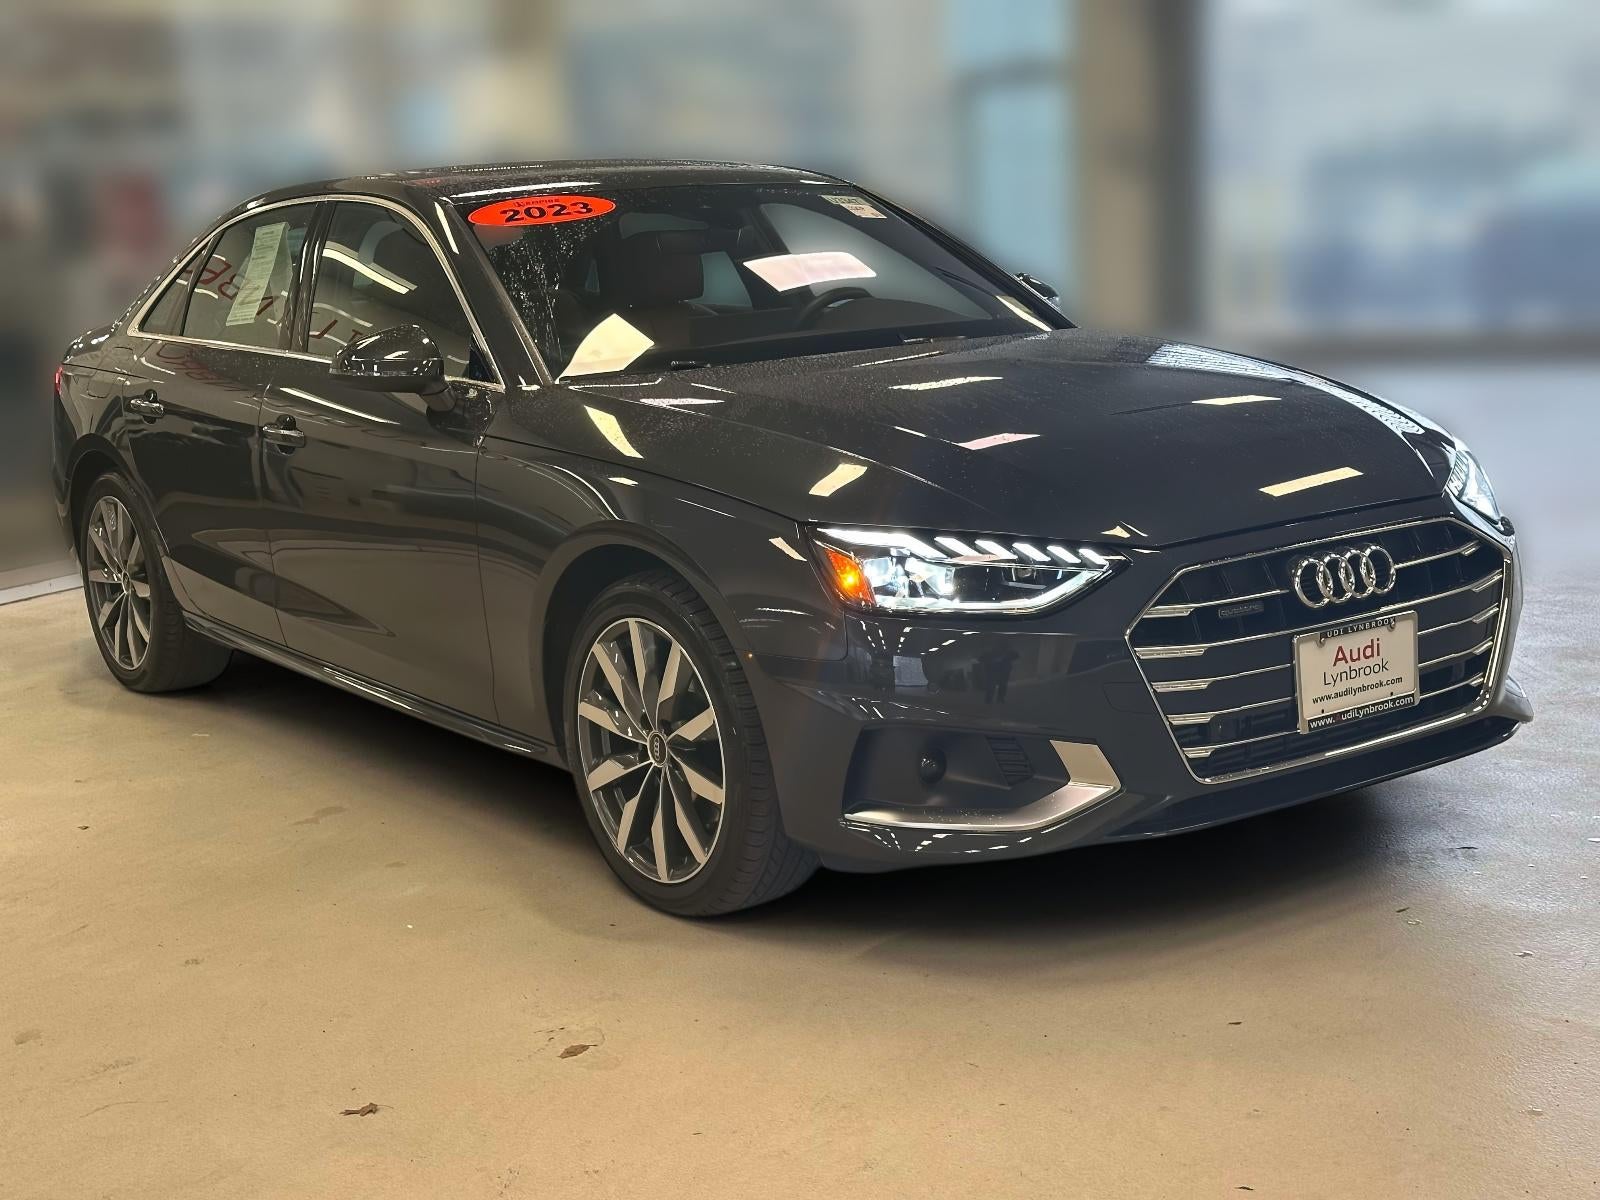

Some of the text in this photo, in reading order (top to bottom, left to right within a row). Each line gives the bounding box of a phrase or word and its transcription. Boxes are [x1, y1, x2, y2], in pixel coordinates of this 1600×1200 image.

[500, 202, 593, 223] 2023
[1324, 628, 1345, 638] UDI
[1332, 637, 1381, 667] Audi
[1323, 658, 1389, 687] Lynbrook
[1311, 676, 1403, 705] www.audilynbrook.com
